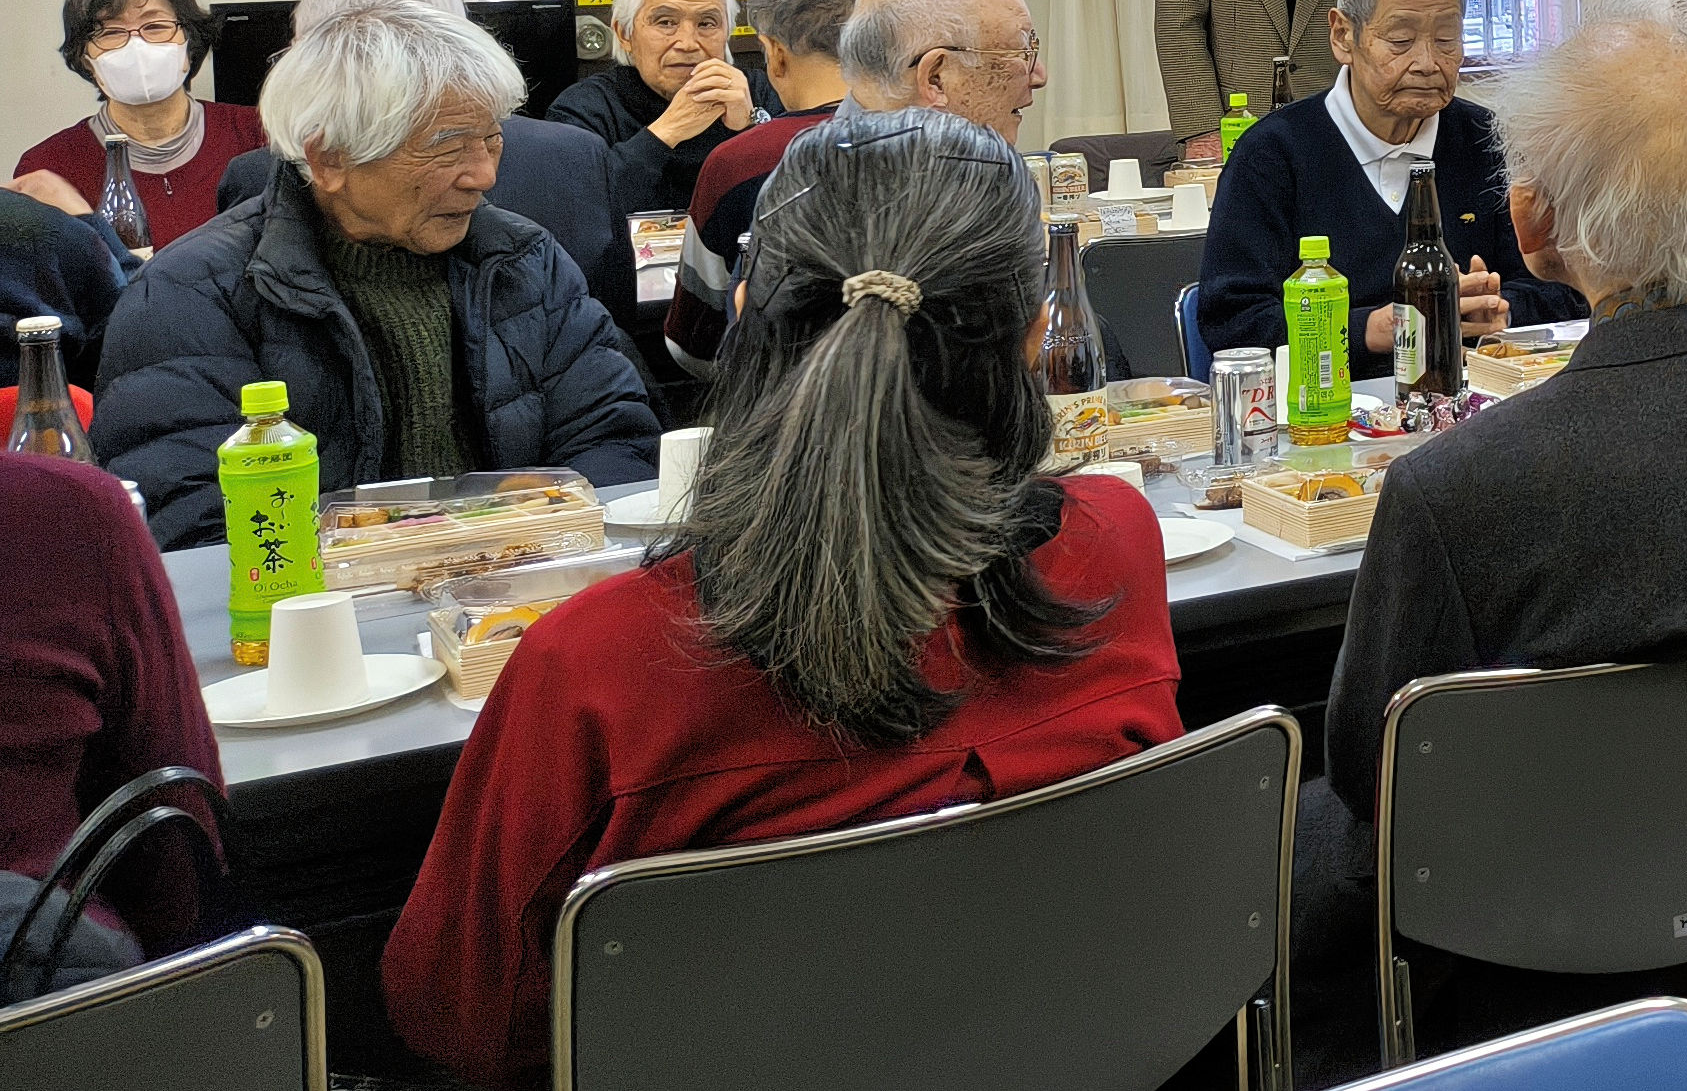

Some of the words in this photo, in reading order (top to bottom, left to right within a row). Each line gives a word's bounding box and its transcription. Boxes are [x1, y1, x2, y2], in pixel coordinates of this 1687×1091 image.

[258, 452, 293, 465] 伊藤園
[250, 510, 293, 573] お茶
[253, 582, 267, 593] Oi
[269, 579, 298, 592] Ocha
